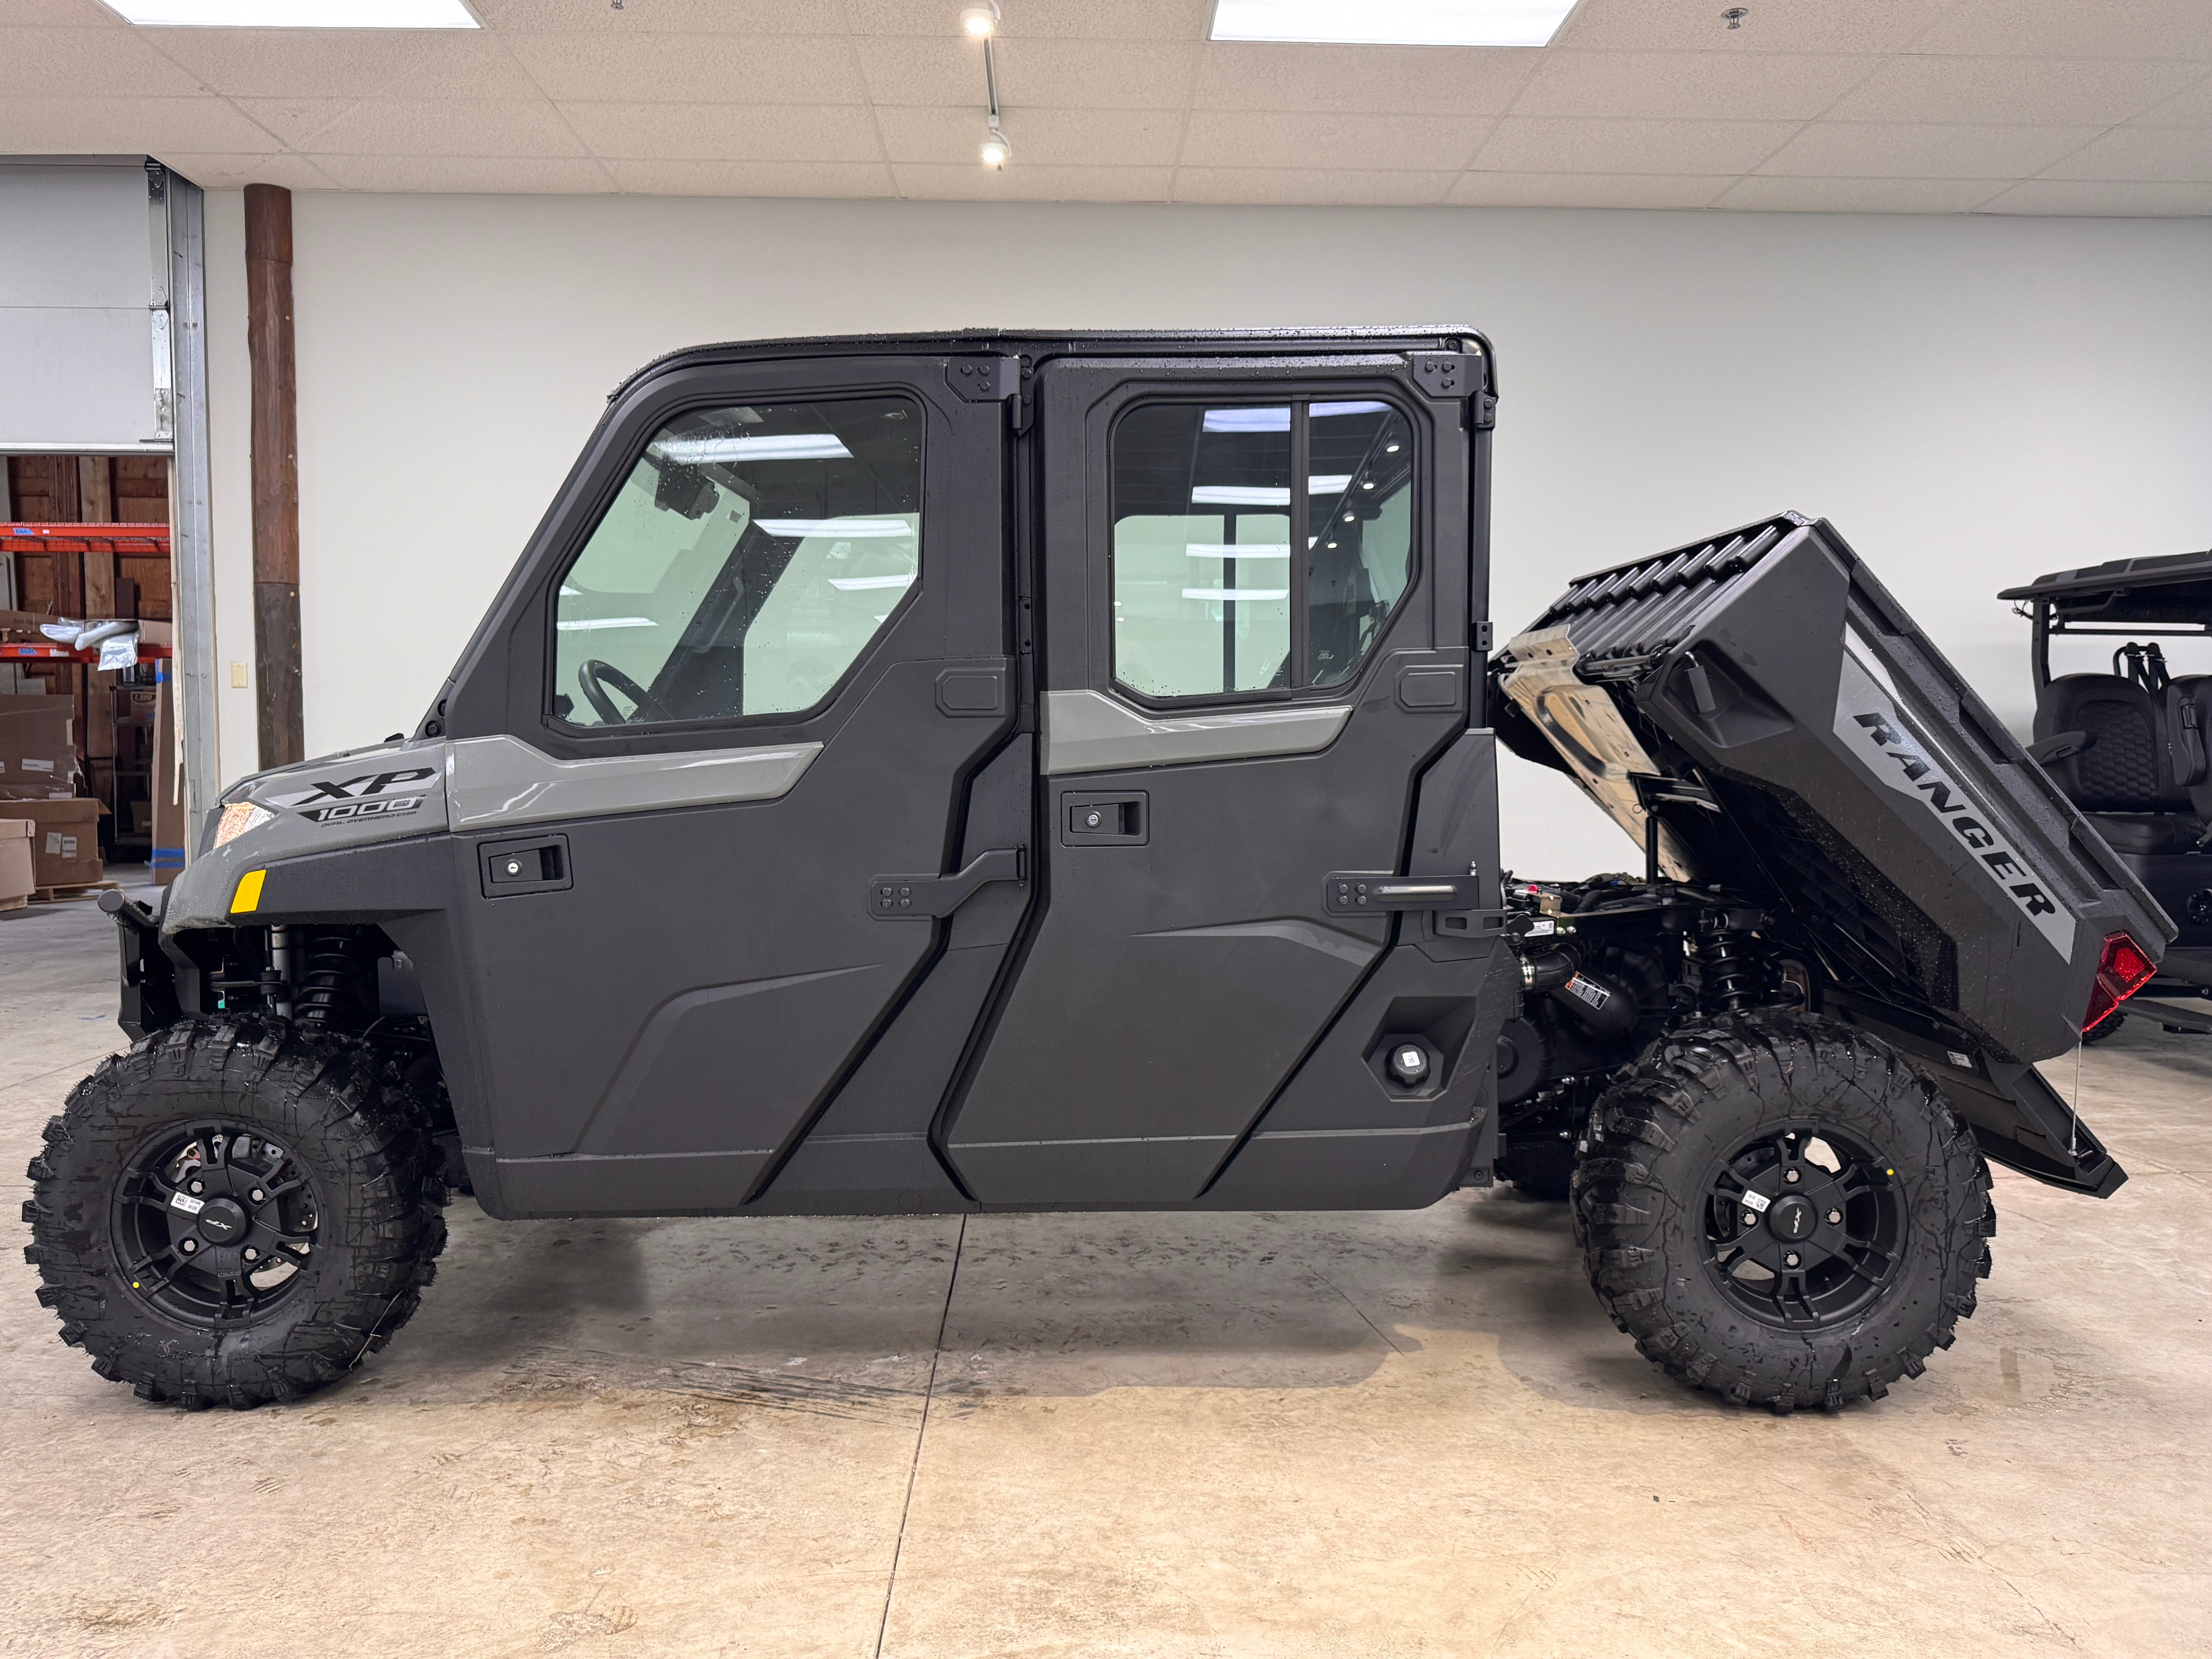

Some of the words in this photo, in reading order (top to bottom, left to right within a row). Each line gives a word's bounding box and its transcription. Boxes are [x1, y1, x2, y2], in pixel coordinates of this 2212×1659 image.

[290, 767, 436, 806] XP
[318, 797, 417, 821] 1000
[347, 814, 395, 824] OVERHEAD
[1853, 713, 2056, 916] RANGER
[205, 1219, 232, 1230] XP
[1793, 1207, 1802, 1234] XP
